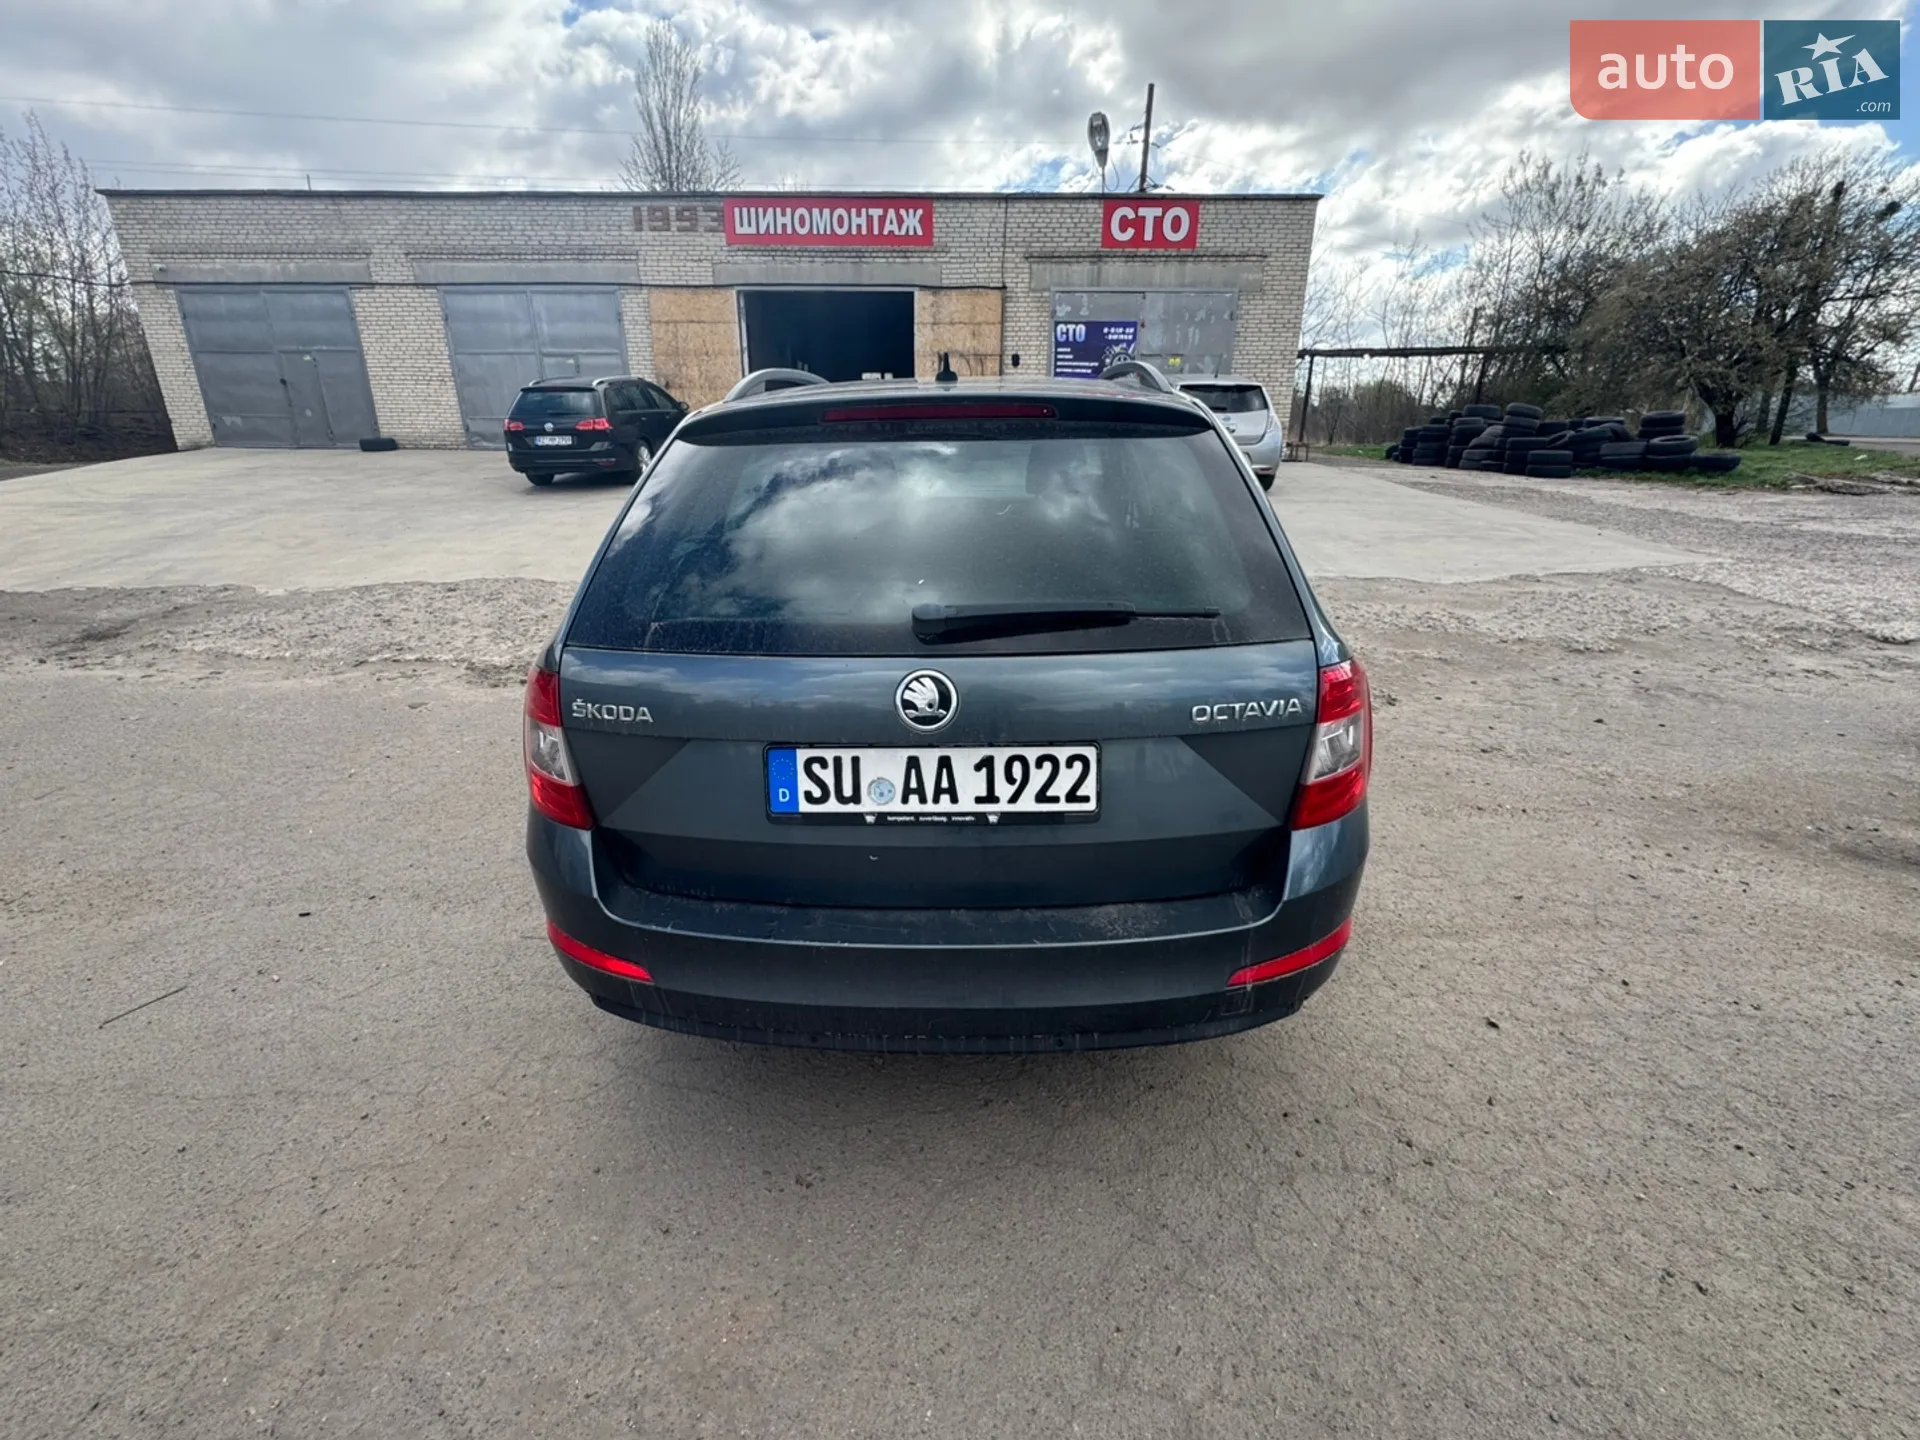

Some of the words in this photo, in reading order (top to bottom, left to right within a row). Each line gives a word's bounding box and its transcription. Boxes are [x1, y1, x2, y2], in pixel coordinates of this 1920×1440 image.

[632, 205, 724, 232] 1993
[733, 206, 924, 236] ШИНОМОНТАЖ
[1110, 206, 1190, 242] СТО
[1056, 323, 1086, 342] СТО
[571, 698, 654, 723] ŠKODA
[1191, 698, 1303, 722] OCTAVIA
[803, 755, 862, 806] SU
[901, 755, 960, 805] AA
[973, 753, 1092, 804] 1922
[778, 788, 790, 803] D
